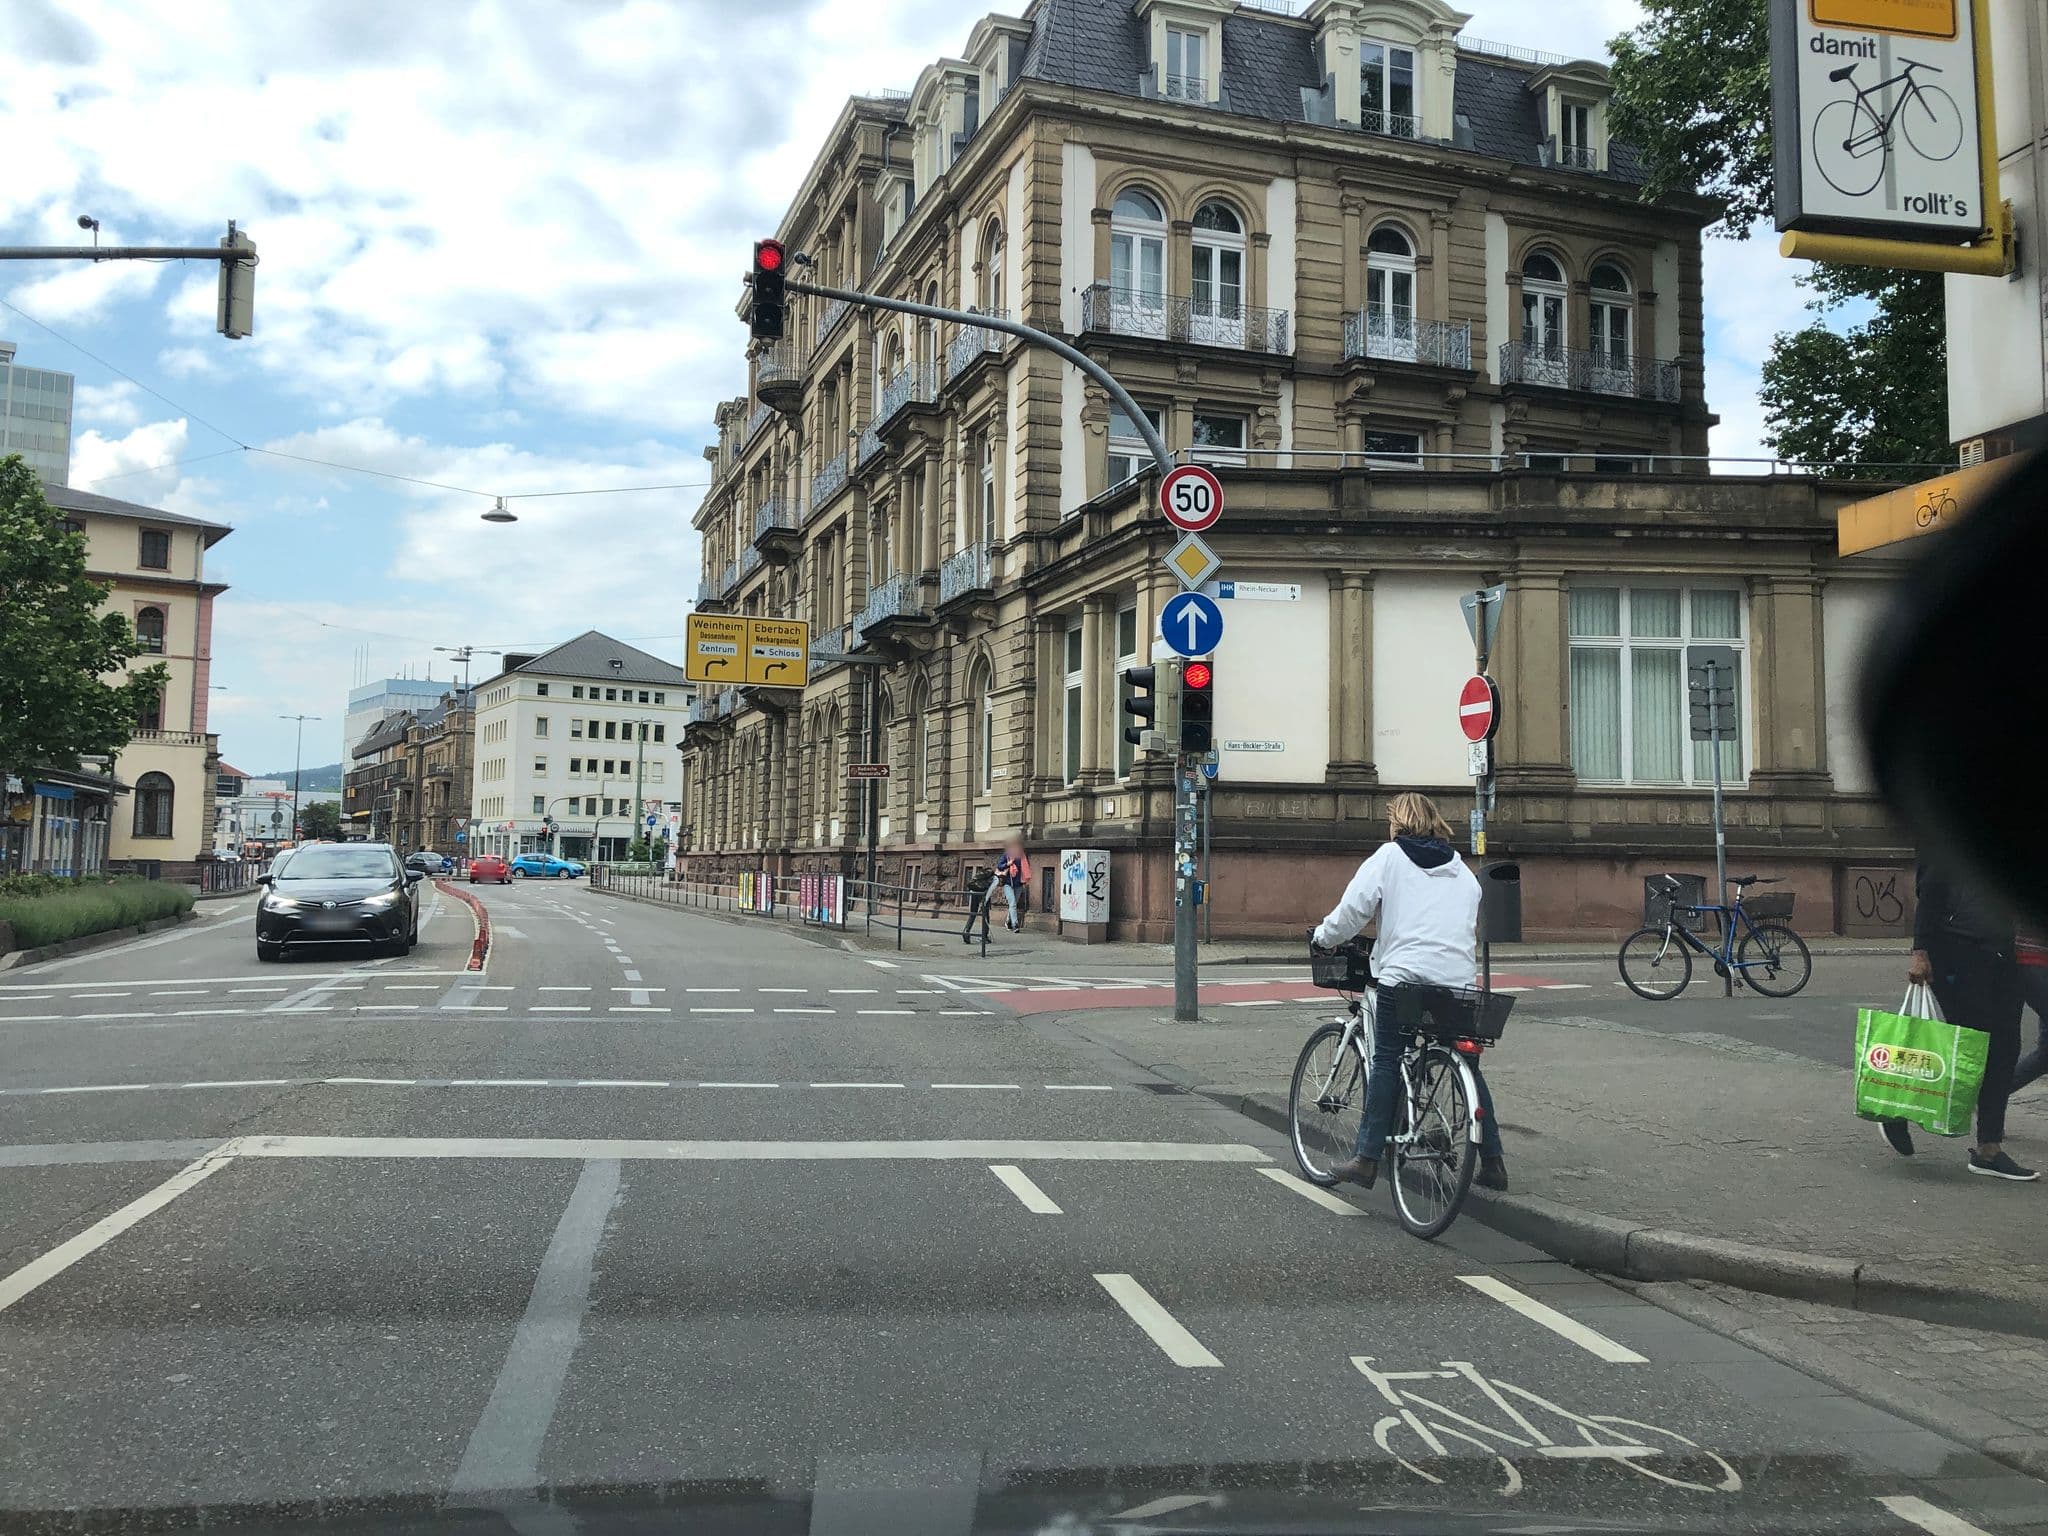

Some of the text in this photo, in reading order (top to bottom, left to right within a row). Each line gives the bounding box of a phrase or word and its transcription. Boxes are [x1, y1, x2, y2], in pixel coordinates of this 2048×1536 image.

[1810, 32, 1877, 58] damit
[1904, 192, 1967, 217] rollt's
[1176, 484, 1210, 512] 50
[1221, 583, 1278, 593] IHK Rhein-Neckar
[694, 620, 744, 632] Weinheim
[754, 623, 801, 635] Eberbach
[755, 635, 799, 646] Neckargemünd
[700, 643, 735, 654] Zentrum
[769, 648, 800, 658] Schloss
[1888, 1062, 1935, 1078] Oriental
